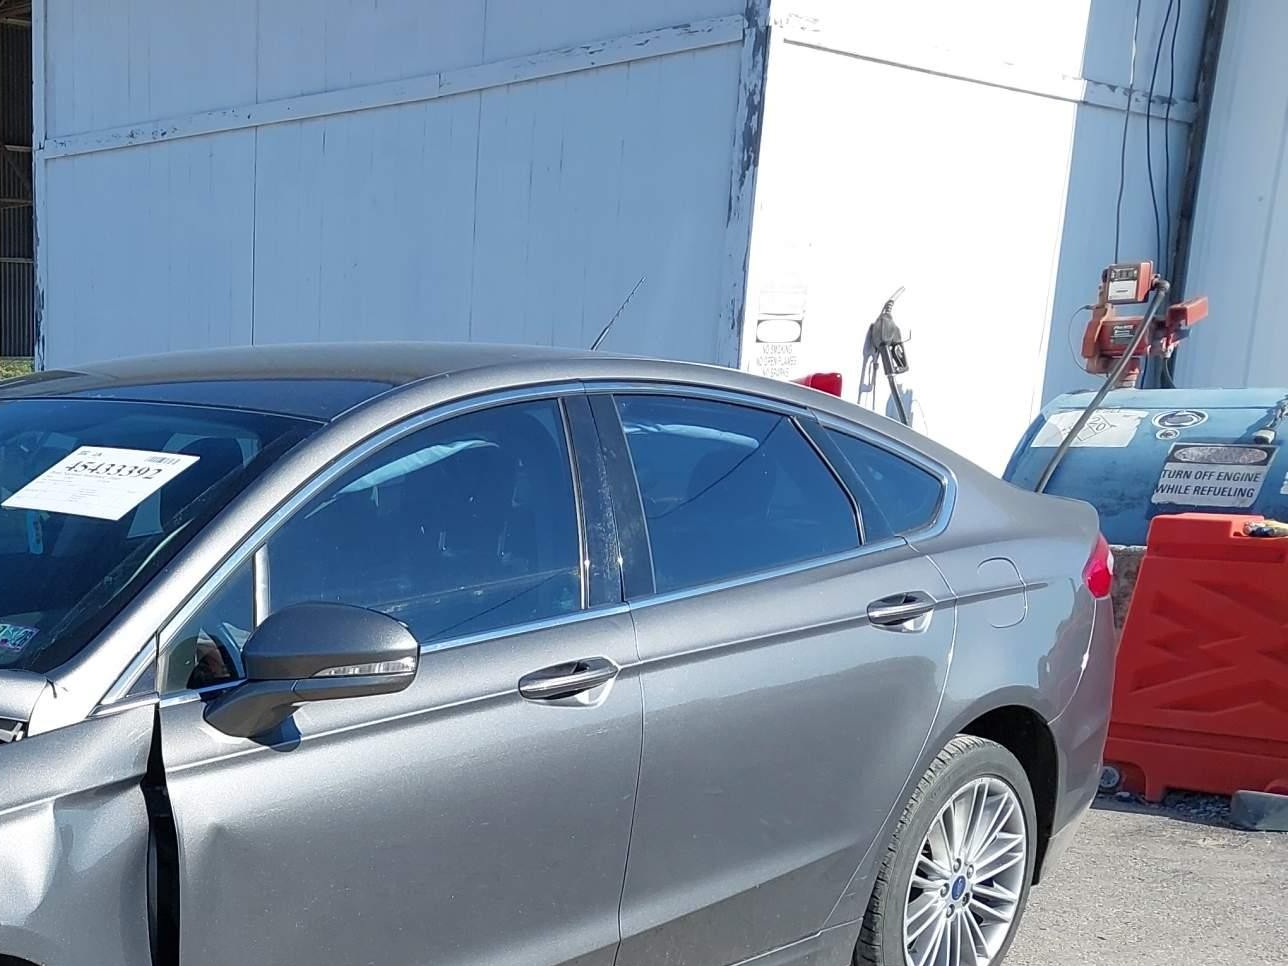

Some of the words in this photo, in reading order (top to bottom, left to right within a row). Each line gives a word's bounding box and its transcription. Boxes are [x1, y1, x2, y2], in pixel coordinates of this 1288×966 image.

[65, 460, 163, 480] 45433392
[1162, 469, 1192, 480] TURN
[1194, 470, 1215, 481] OFF
[1216, 471, 1262, 482] ENGINE
[1155, 484, 1191, 495] WHILE
[1192, 486, 1256, 498] REFUELING
